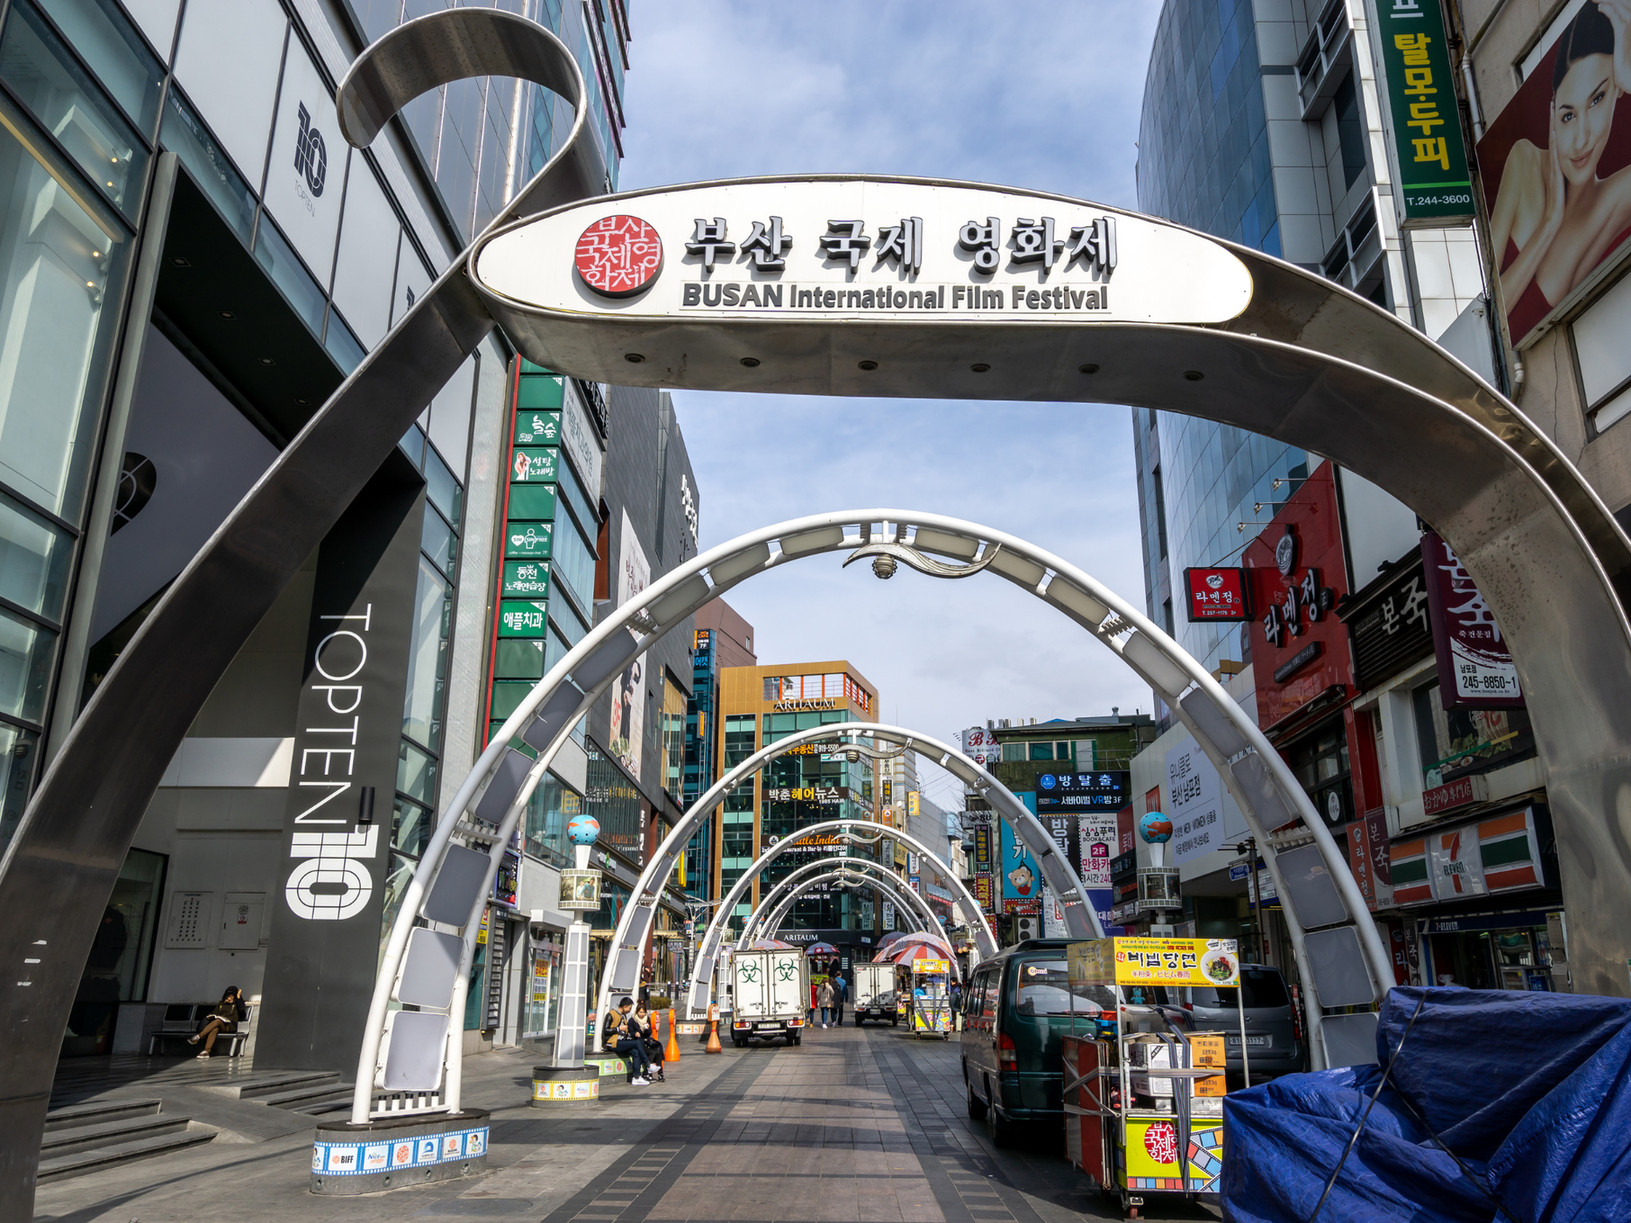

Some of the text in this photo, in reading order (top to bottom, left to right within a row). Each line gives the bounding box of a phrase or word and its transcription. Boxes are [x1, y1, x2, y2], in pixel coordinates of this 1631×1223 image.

[294, 179, 316, 218] TOPTEN
[685, 216, 1118, 275] 부산 국제 영화제
[683, 283, 1108, 310] BUSAN International Film Festival
[504, 582, 546, 592] 노래연습장
[1195, 591, 1233, 604] 라멘정
[1382, 576, 1428, 635] 본죽
[1264, 568, 1318, 648] 라멘정
[503, 612, 543, 630] 애플치과
[1460, 664, 1477, 674] 남포점
[1462, 675, 1517, 689] 245-8850~1
[294, 603, 372, 824] TOPTEN
[774, 698, 835, 711] ARITAUM
[1058, 774, 1113, 787] 방탈출
[1061, 796, 1091, 805] 서바이벌
[1092, 847, 1105, 855] 2F
[1369, 822, 1390, 874] 본죽
[285, 824, 380, 920] 10
[1127, 951, 1198, 969] 비빔당면
[340, 1155, 354, 1164] BIFF
